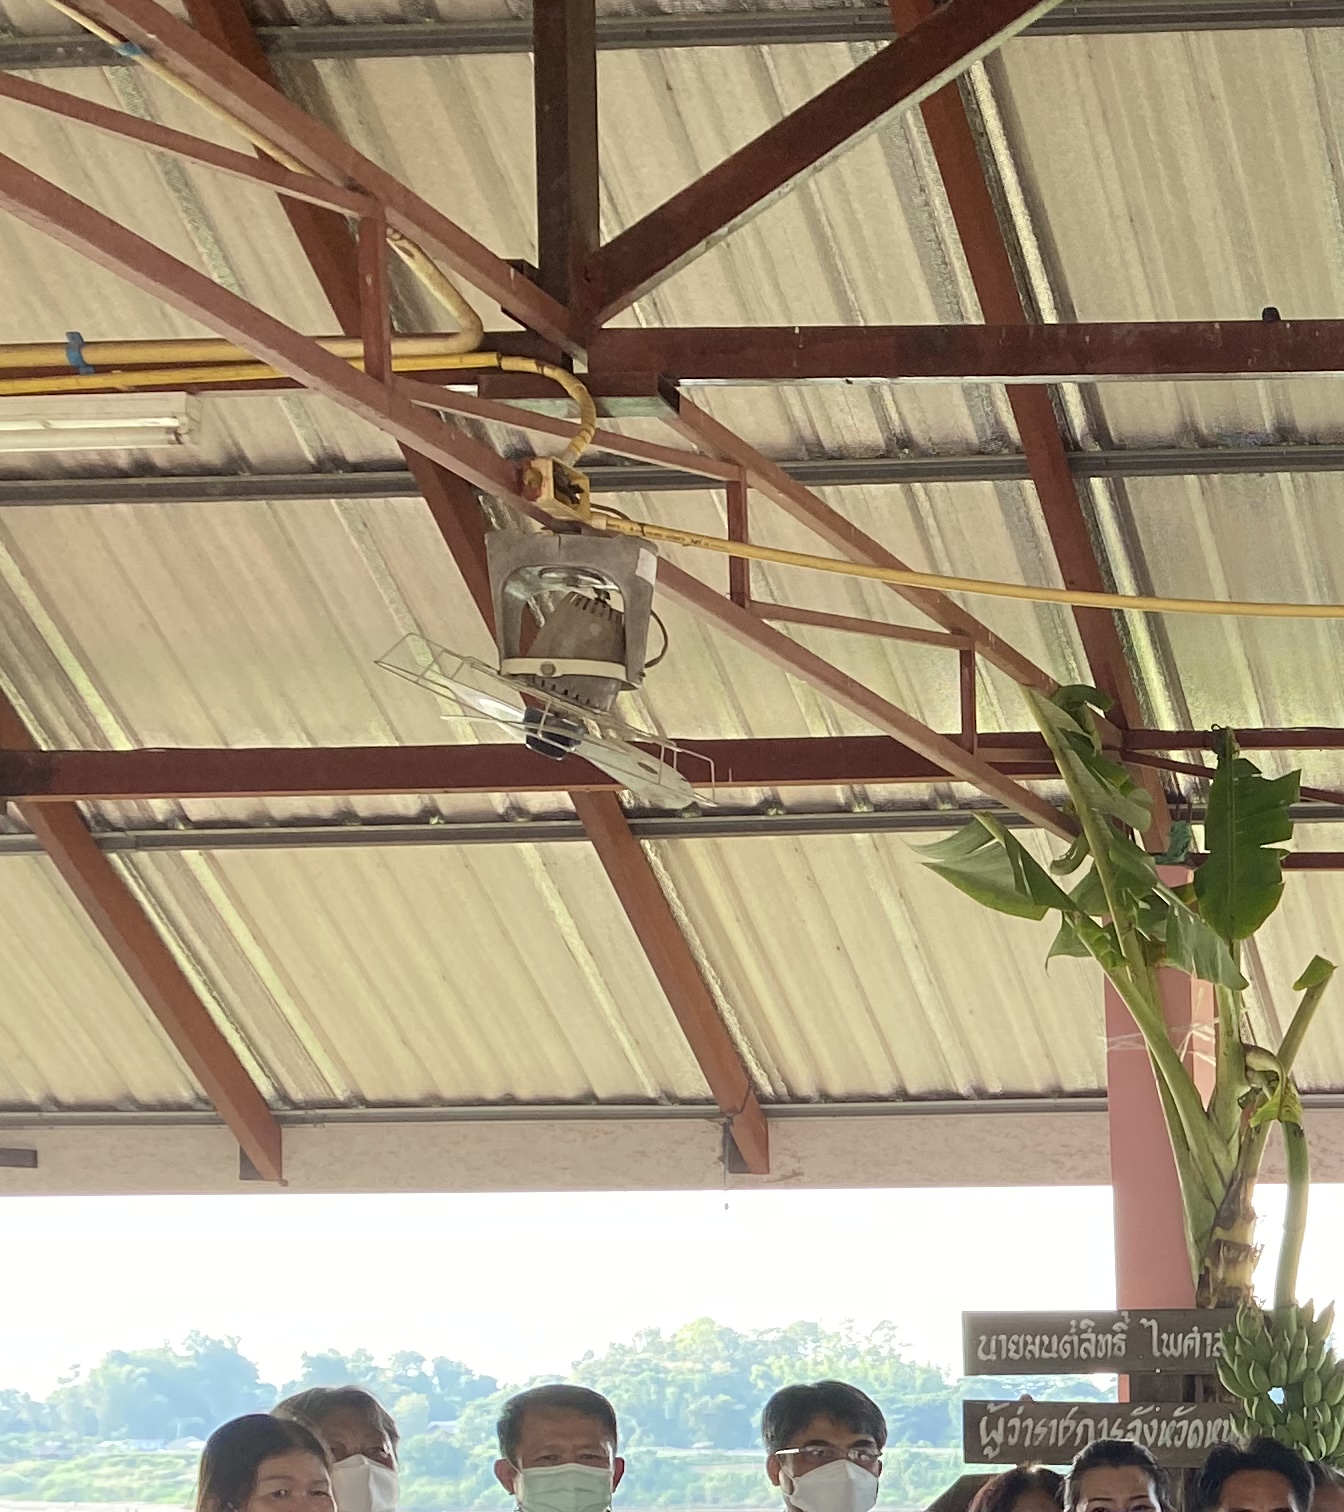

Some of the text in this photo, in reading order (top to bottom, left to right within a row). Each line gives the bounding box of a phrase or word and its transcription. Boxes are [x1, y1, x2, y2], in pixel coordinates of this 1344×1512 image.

[977, 1311, 1131, 1361] นายมนต์สิทธิ์
